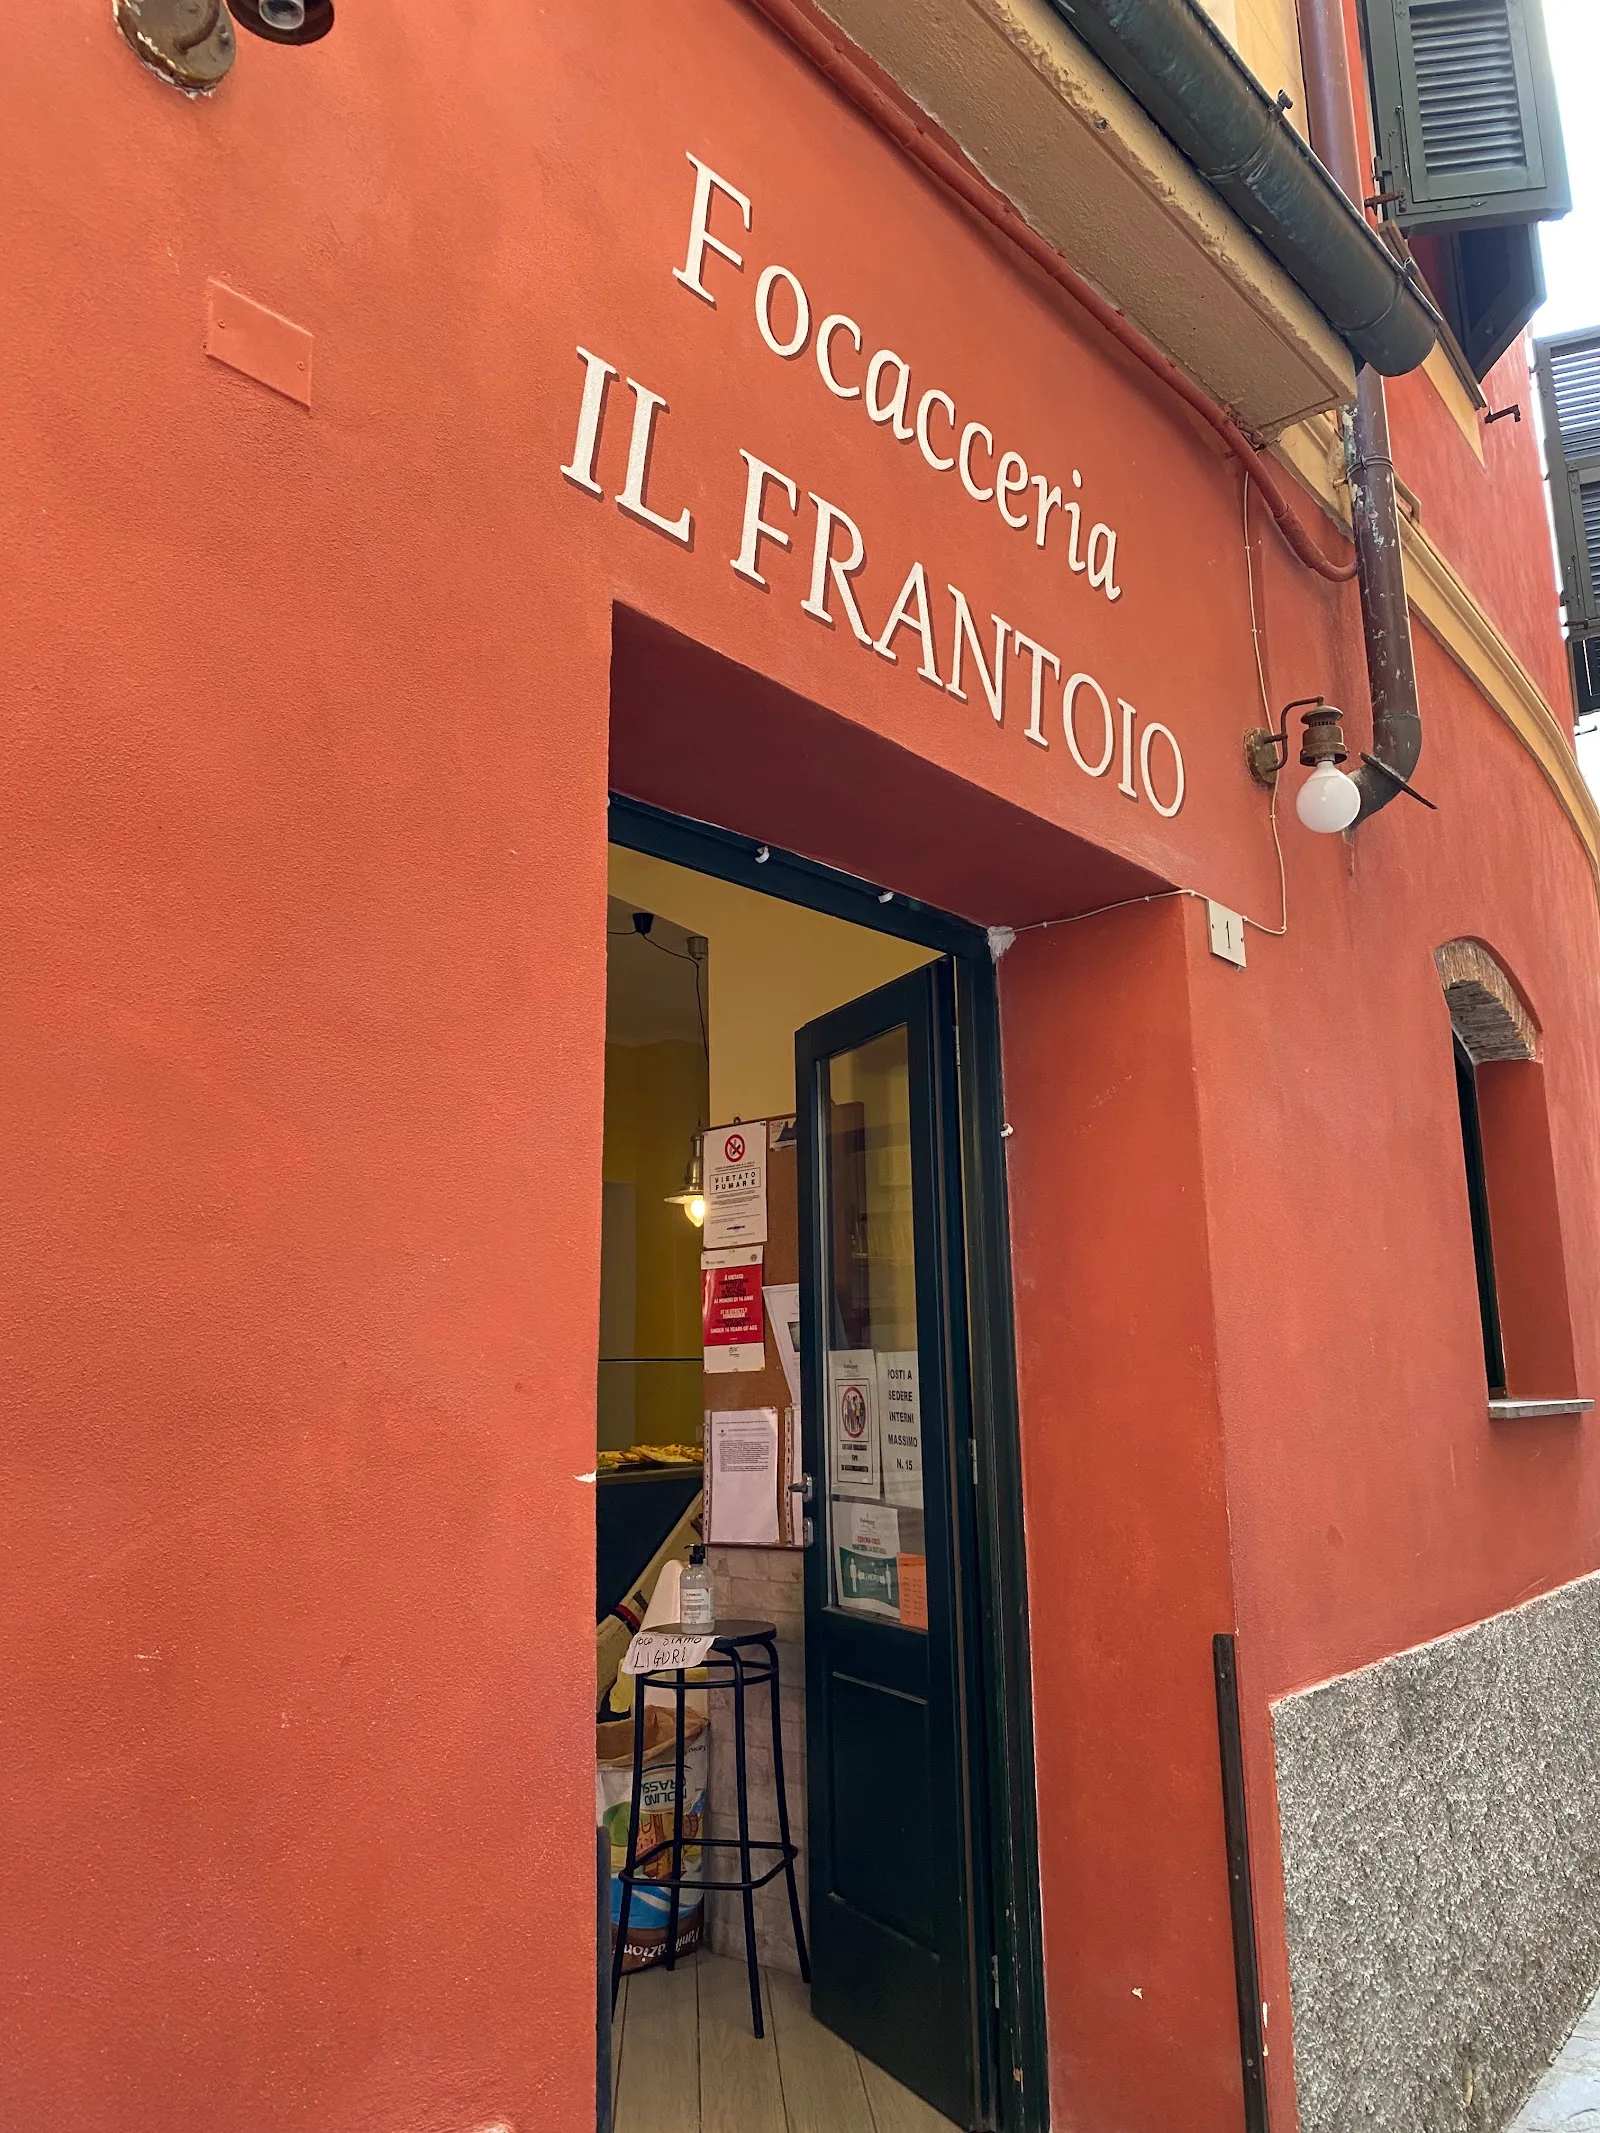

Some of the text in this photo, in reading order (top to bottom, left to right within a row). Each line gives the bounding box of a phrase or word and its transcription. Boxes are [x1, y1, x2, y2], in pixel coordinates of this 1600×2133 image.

[671, 150, 1122, 601] Focacceria
[559, 345, 1185, 818] IL FRANTOIO
[714, 1171, 756, 1184] VIETATO
[715, 1179, 756, 1191] FUMARE
[907, 1370, 913, 1380] A
[888, 1390, 913, 1402] SEDERE
[889, 1411, 915, 1424] INTERNI
[887, 1433, 918, 1448] MASSIMO
[896, 1458, 913, 1471] N. 15
[633, 1646, 686, 1668] LIGURI
[644, 1787, 687, 1806] OLINO
